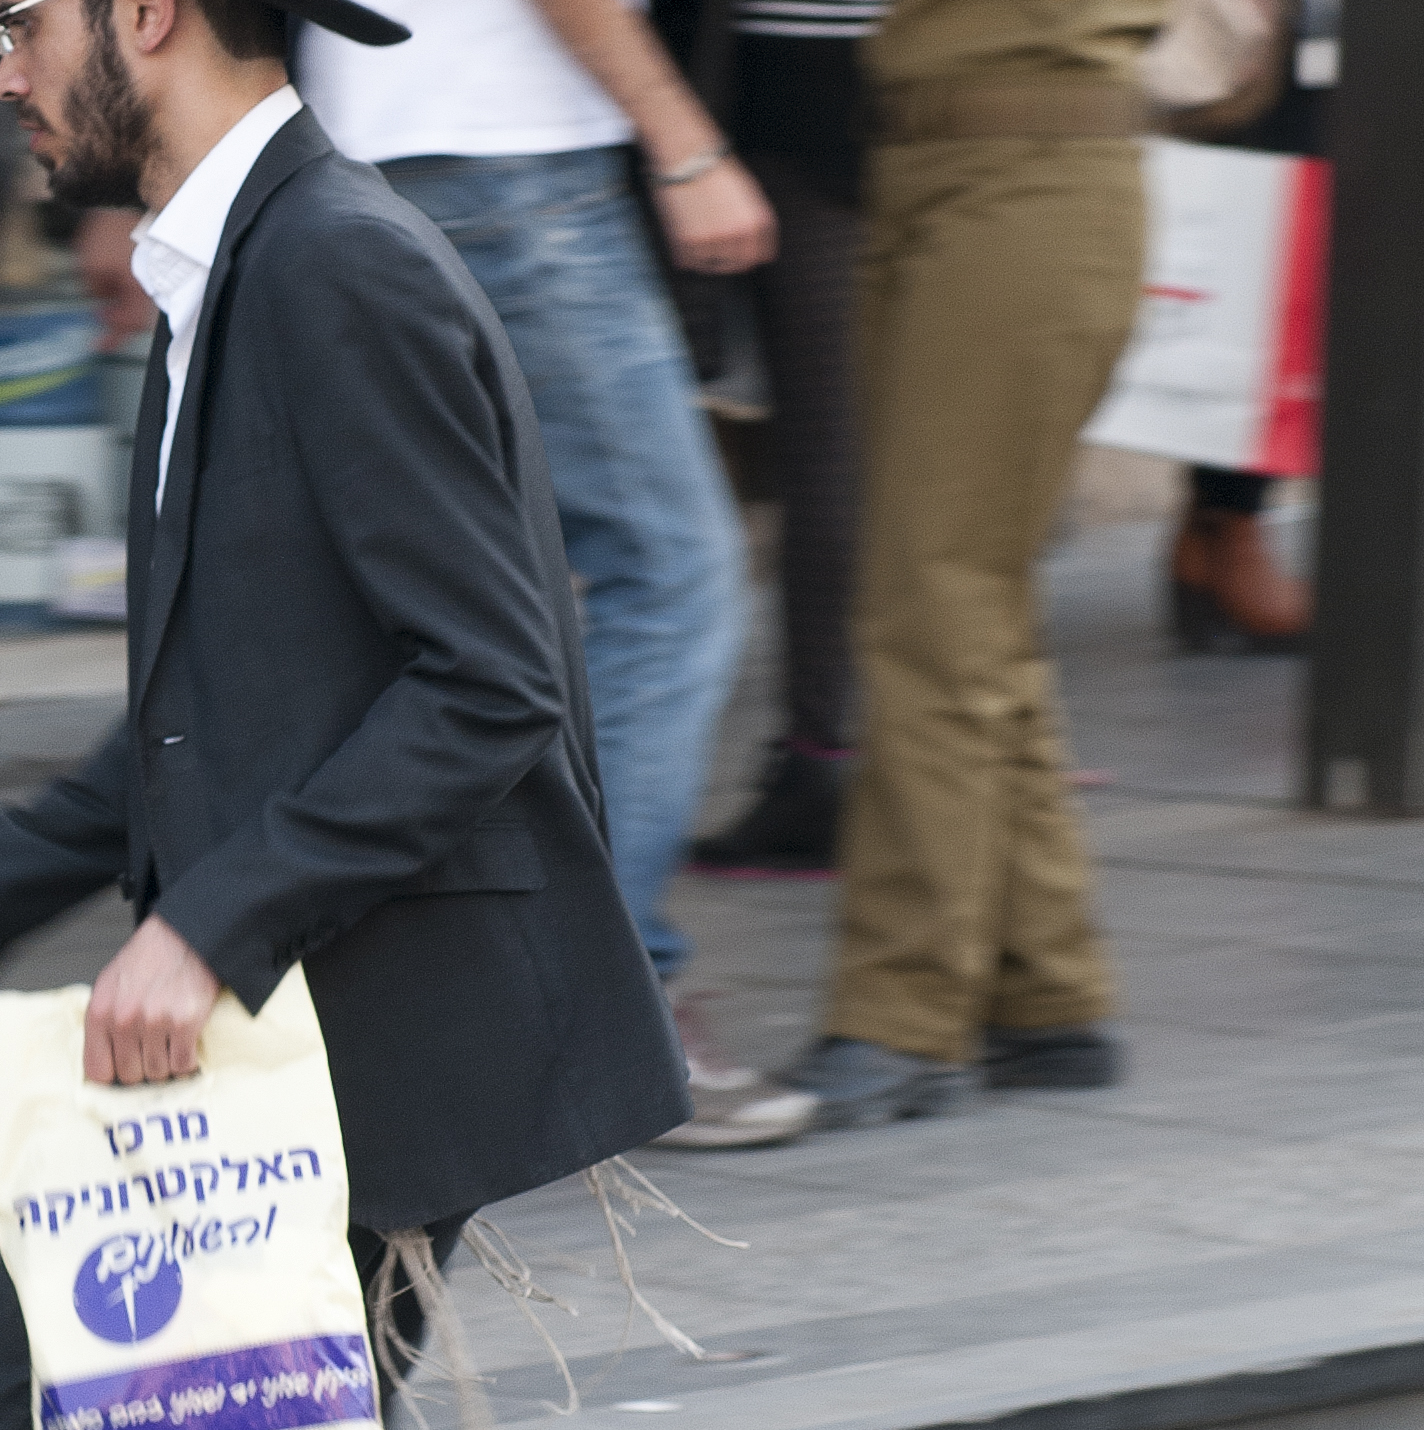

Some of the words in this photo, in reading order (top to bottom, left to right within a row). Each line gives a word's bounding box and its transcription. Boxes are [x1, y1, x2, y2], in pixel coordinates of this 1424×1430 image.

[103, 1109, 211, 1157] מרכז
[12, 1144, 322, 1234] האלקטרוניקה
[94, 1205, 278, 1286] והשעונים
